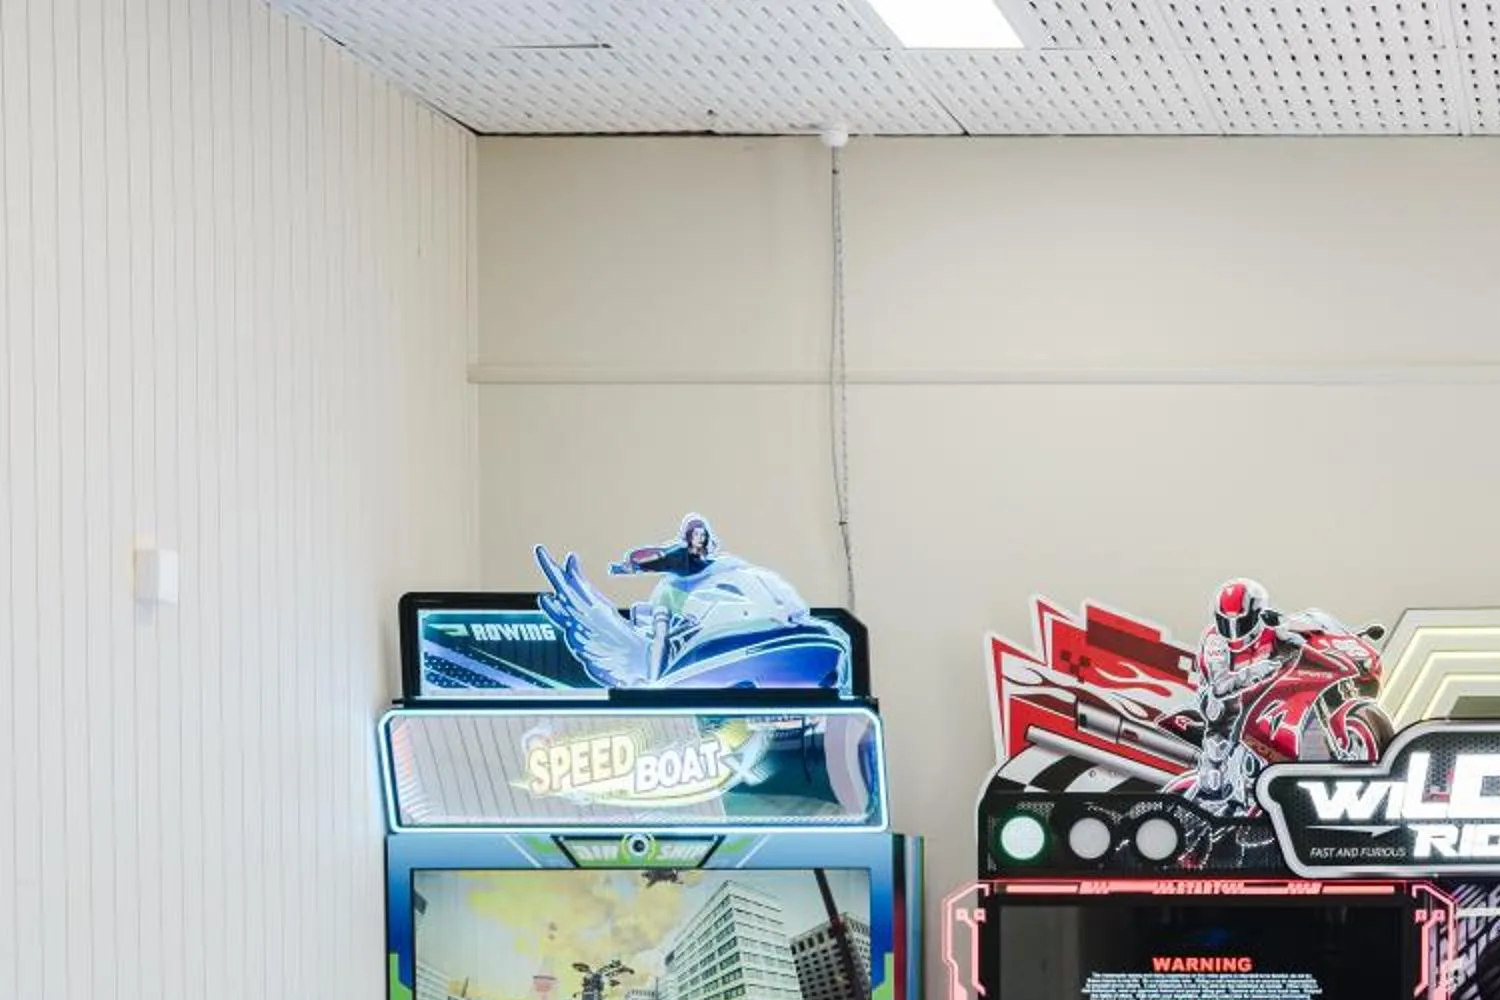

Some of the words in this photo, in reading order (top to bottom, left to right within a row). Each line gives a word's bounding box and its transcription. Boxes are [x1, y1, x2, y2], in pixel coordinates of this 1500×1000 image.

[469, 622, 557, 642] ROWING
[527, 734, 635, 795] SPEED
[635, 739, 722, 794] BOAT
[1309, 847, 1334, 859] FAST
[1335, 847, 1359, 859] AND
[1360, 846, 1408, 858] FURIOUS
[1151, 956, 1253, 973] WARNING
